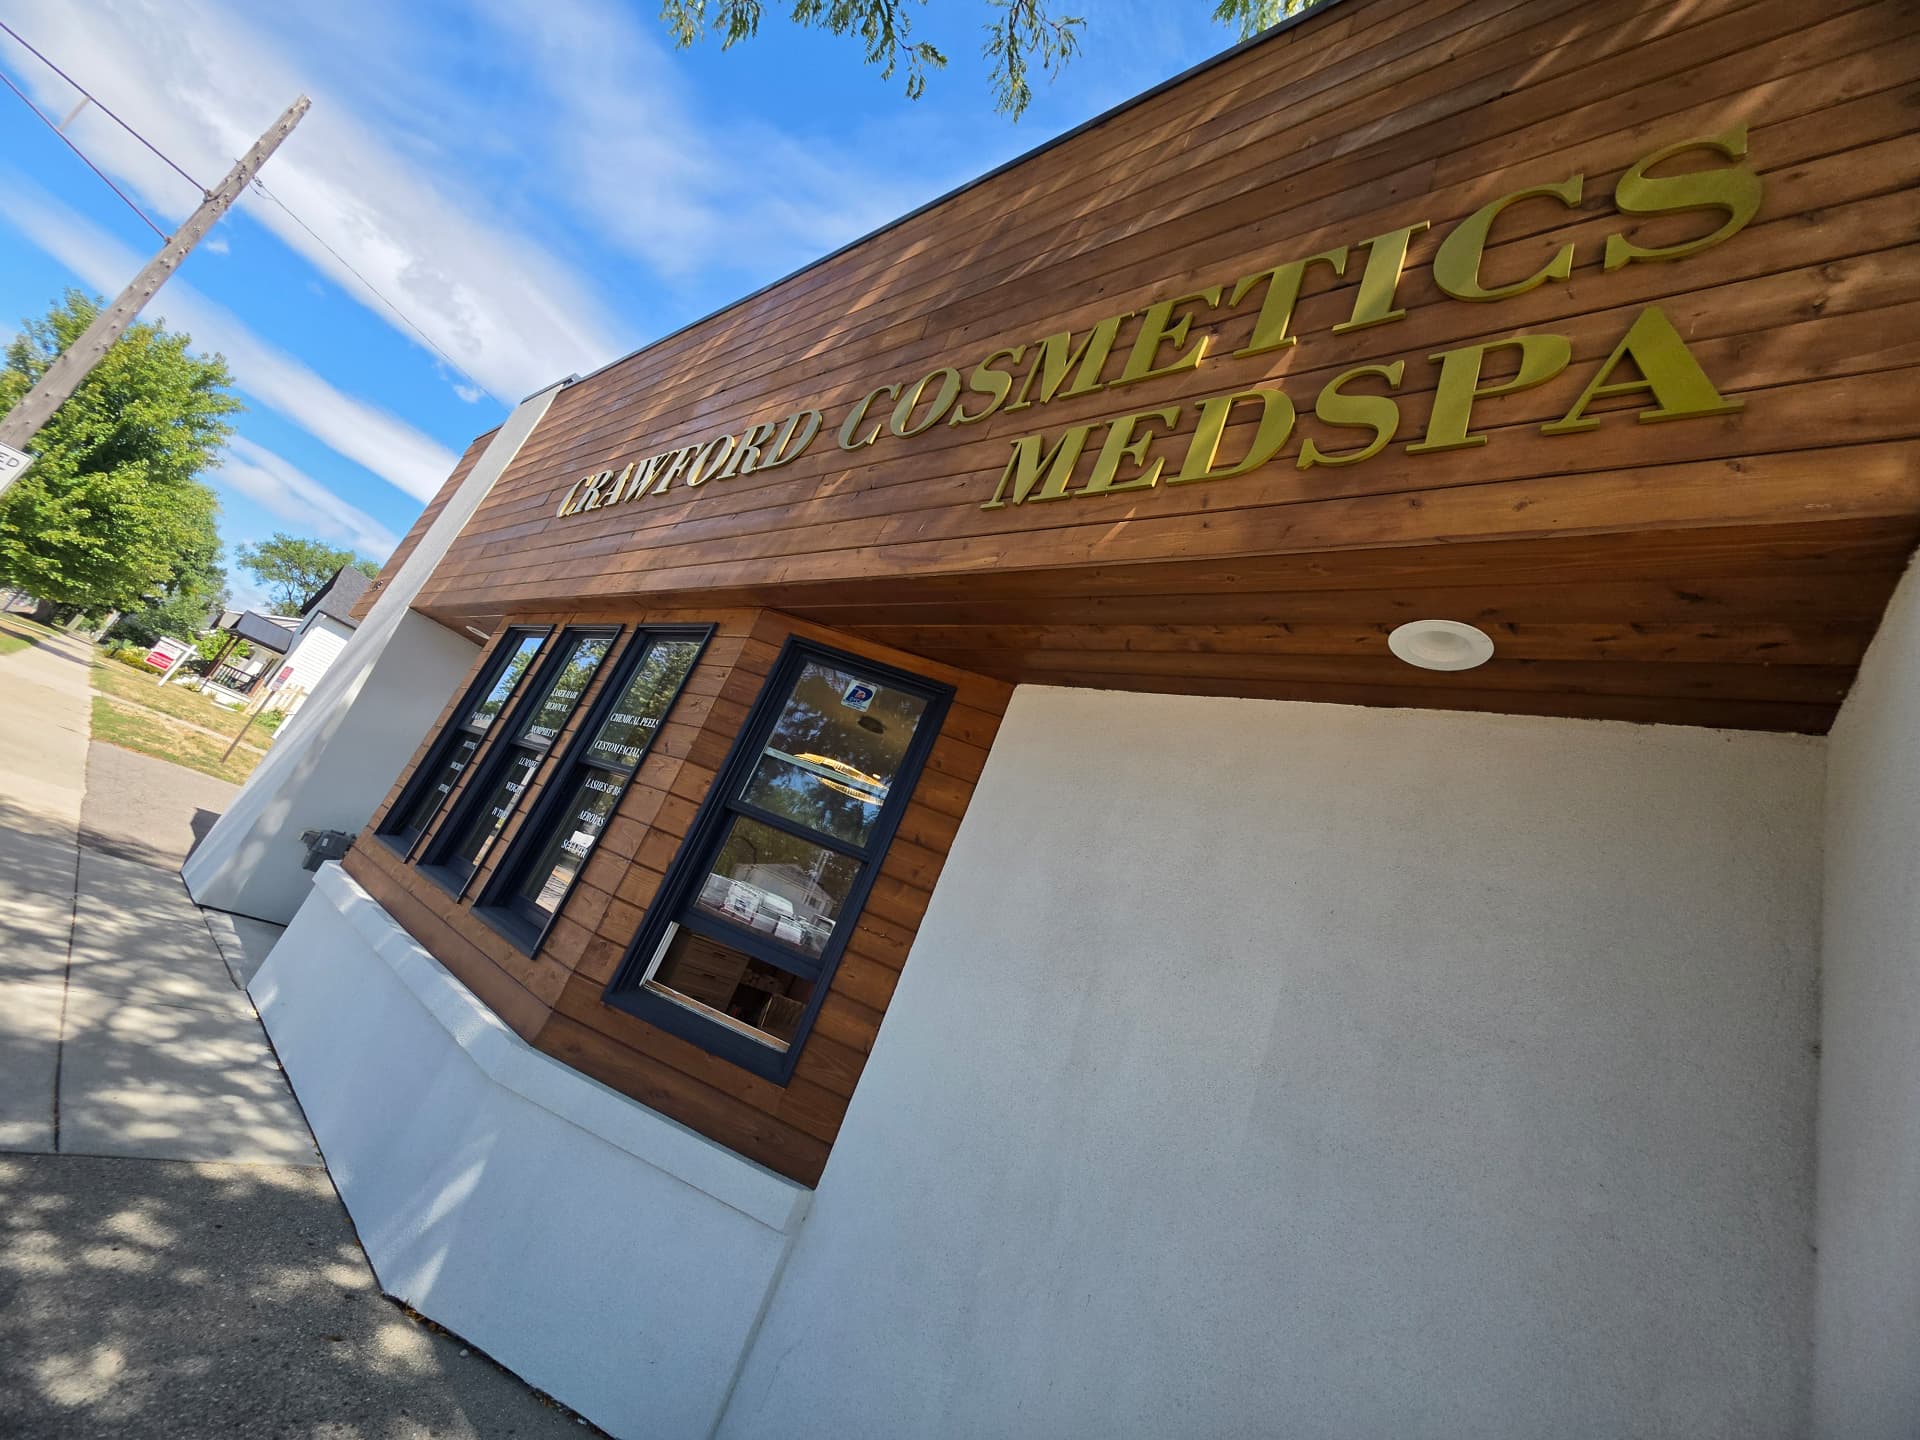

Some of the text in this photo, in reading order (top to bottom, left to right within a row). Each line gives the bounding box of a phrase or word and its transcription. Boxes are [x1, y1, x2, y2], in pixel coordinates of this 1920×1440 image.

[556, 122, 1764, 518] CRAWFORD COSMETICS
[980, 306, 1746, 510] MEDSPA
[610, 713, 641, 727] CHEMICAL
[595, 740, 620, 754] CUSTOM
[585, 778, 608, 792] LASHES
